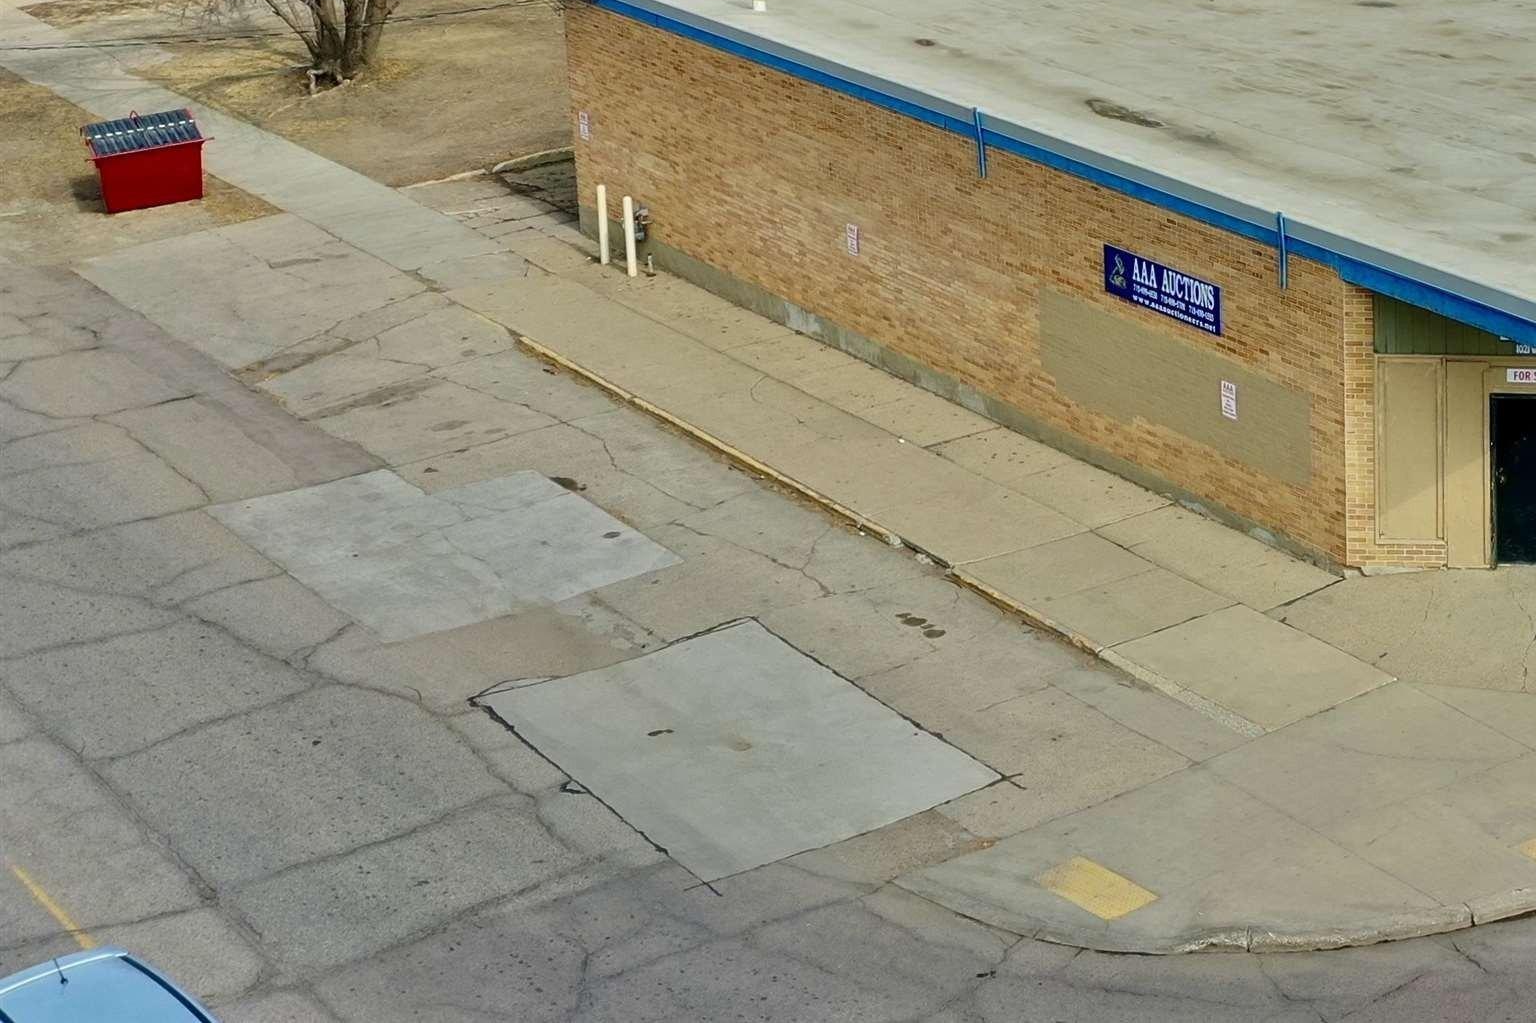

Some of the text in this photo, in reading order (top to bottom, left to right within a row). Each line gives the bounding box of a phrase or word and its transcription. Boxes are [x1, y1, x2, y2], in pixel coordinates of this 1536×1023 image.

[1132, 257, 1158, 289] AAA
[1161, 269, 1215, 311] AUCTIONS
[1513, 370, 1531, 382] FOR
